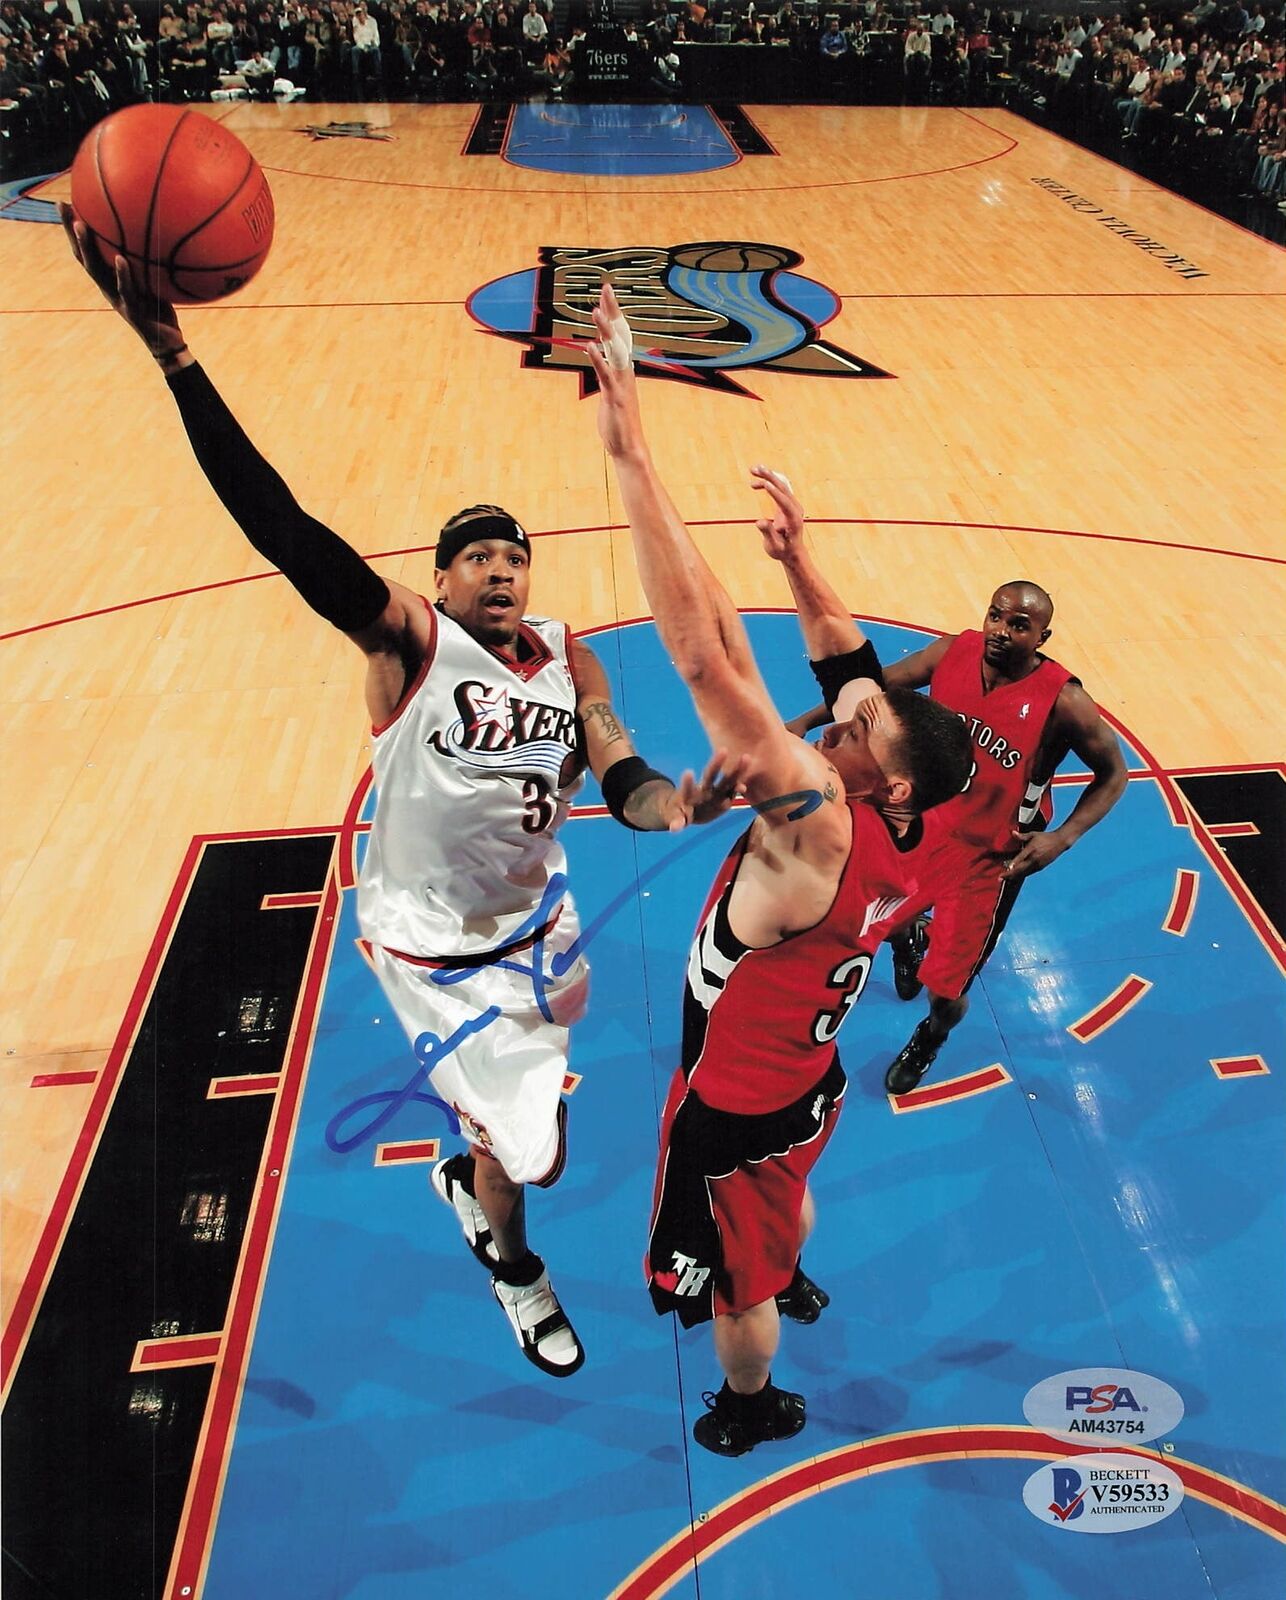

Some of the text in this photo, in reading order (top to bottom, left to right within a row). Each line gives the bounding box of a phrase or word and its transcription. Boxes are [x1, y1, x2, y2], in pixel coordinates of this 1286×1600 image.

[586, 49, 629, 65] 76ers
[1096, 216, 1211, 279] WACHOVIA
[521, 775, 553, 835] 3
